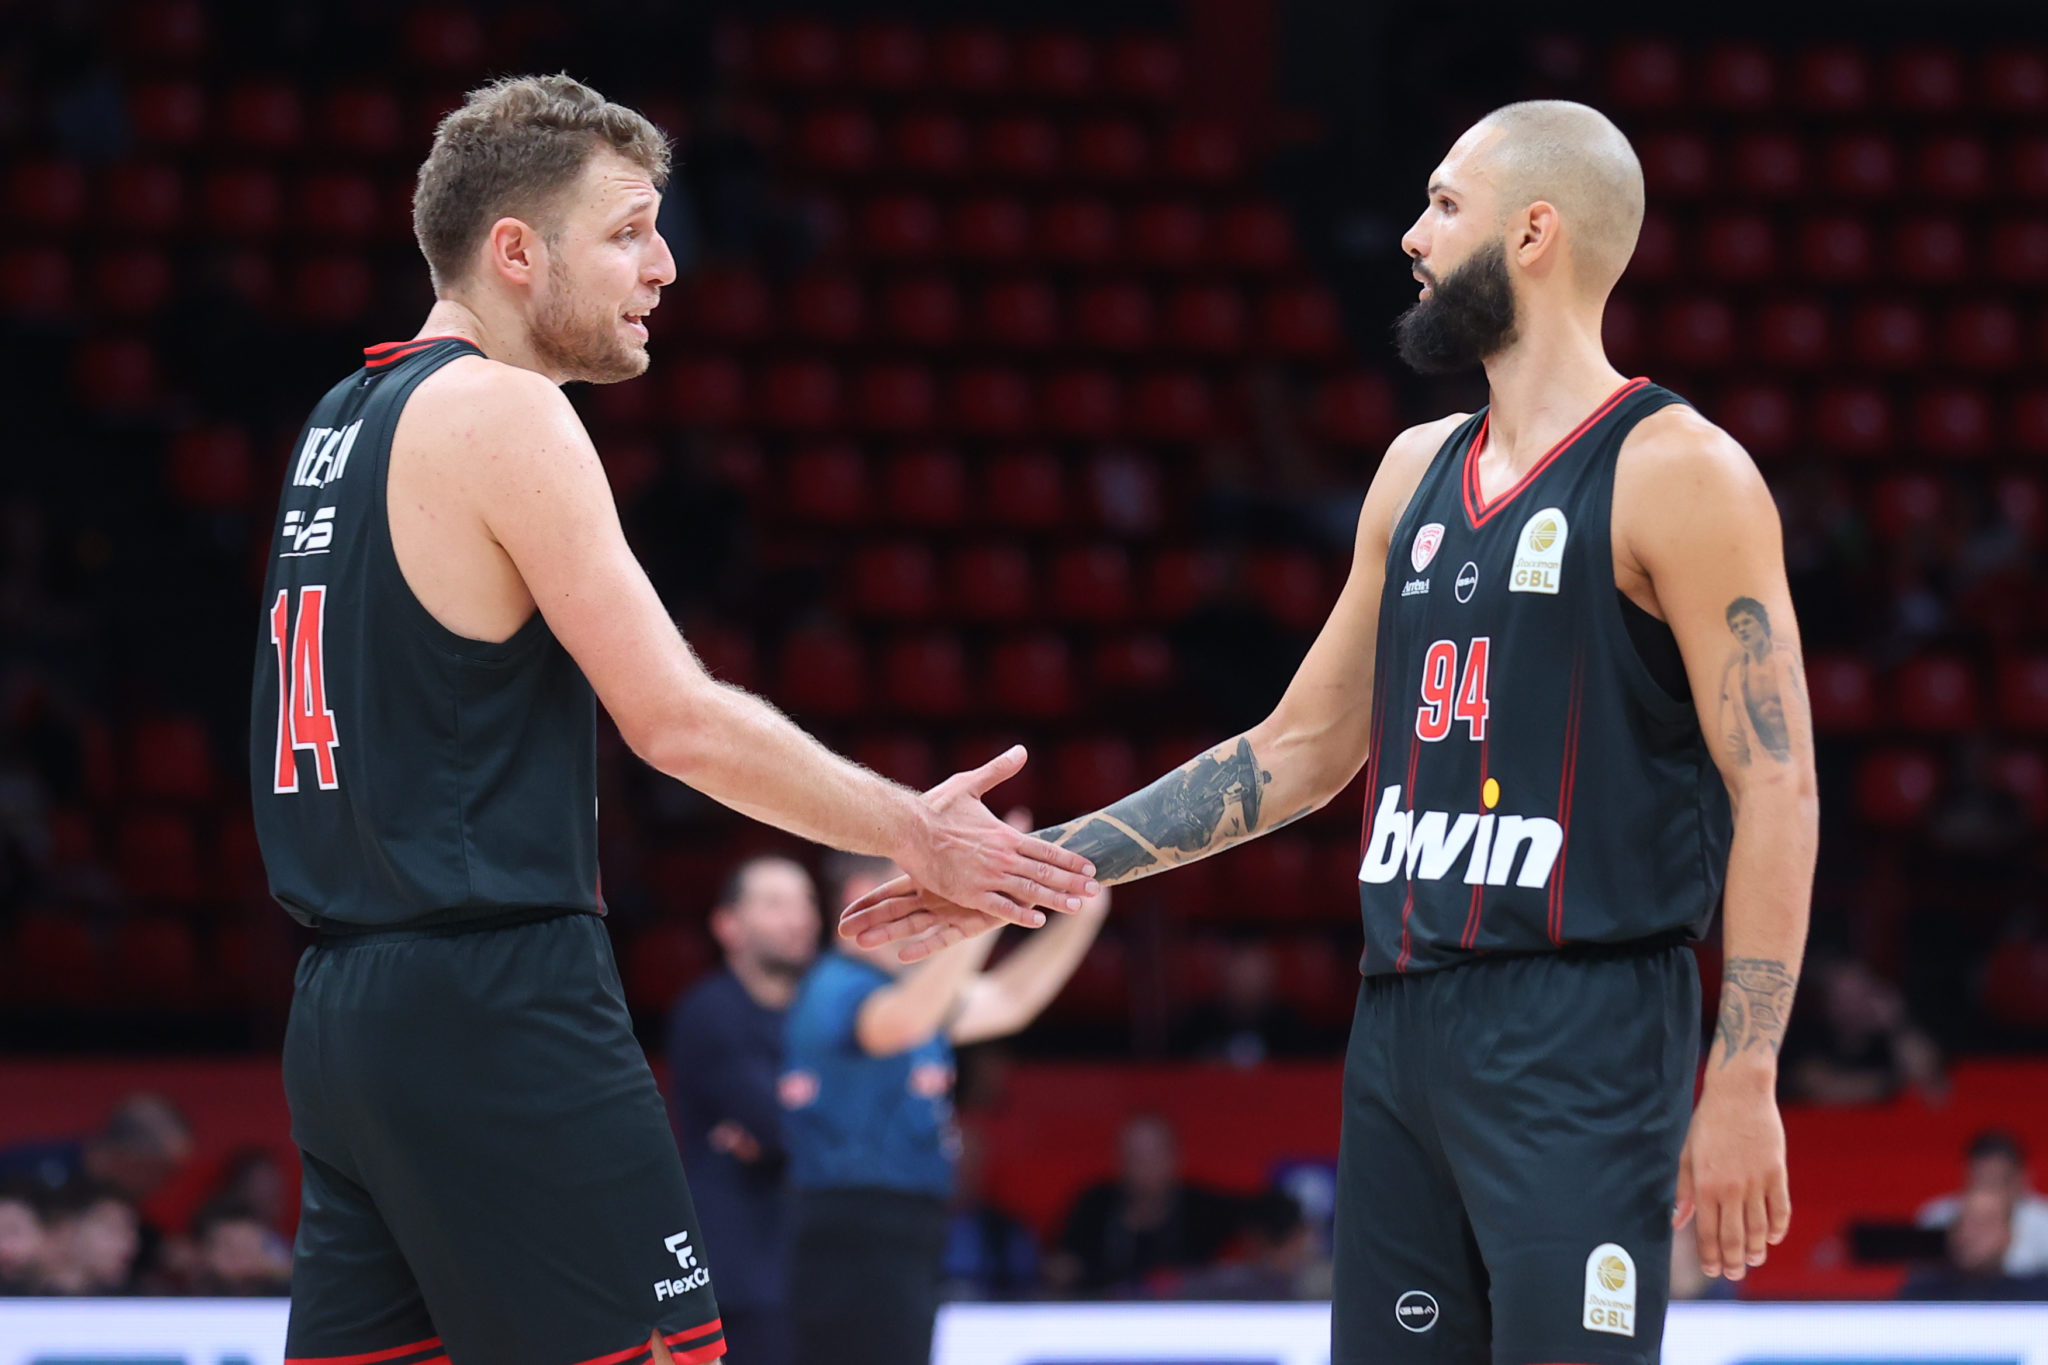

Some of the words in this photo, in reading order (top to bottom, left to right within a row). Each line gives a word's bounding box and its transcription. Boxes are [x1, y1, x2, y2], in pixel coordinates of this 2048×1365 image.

[1515, 569, 1554, 588] GBL
[270, 584, 340, 794] 14
[1415, 636, 1490, 742] 94
[1358, 777, 1565, 888] bwin
[1590, 1307, 1630, 1330] GBL
